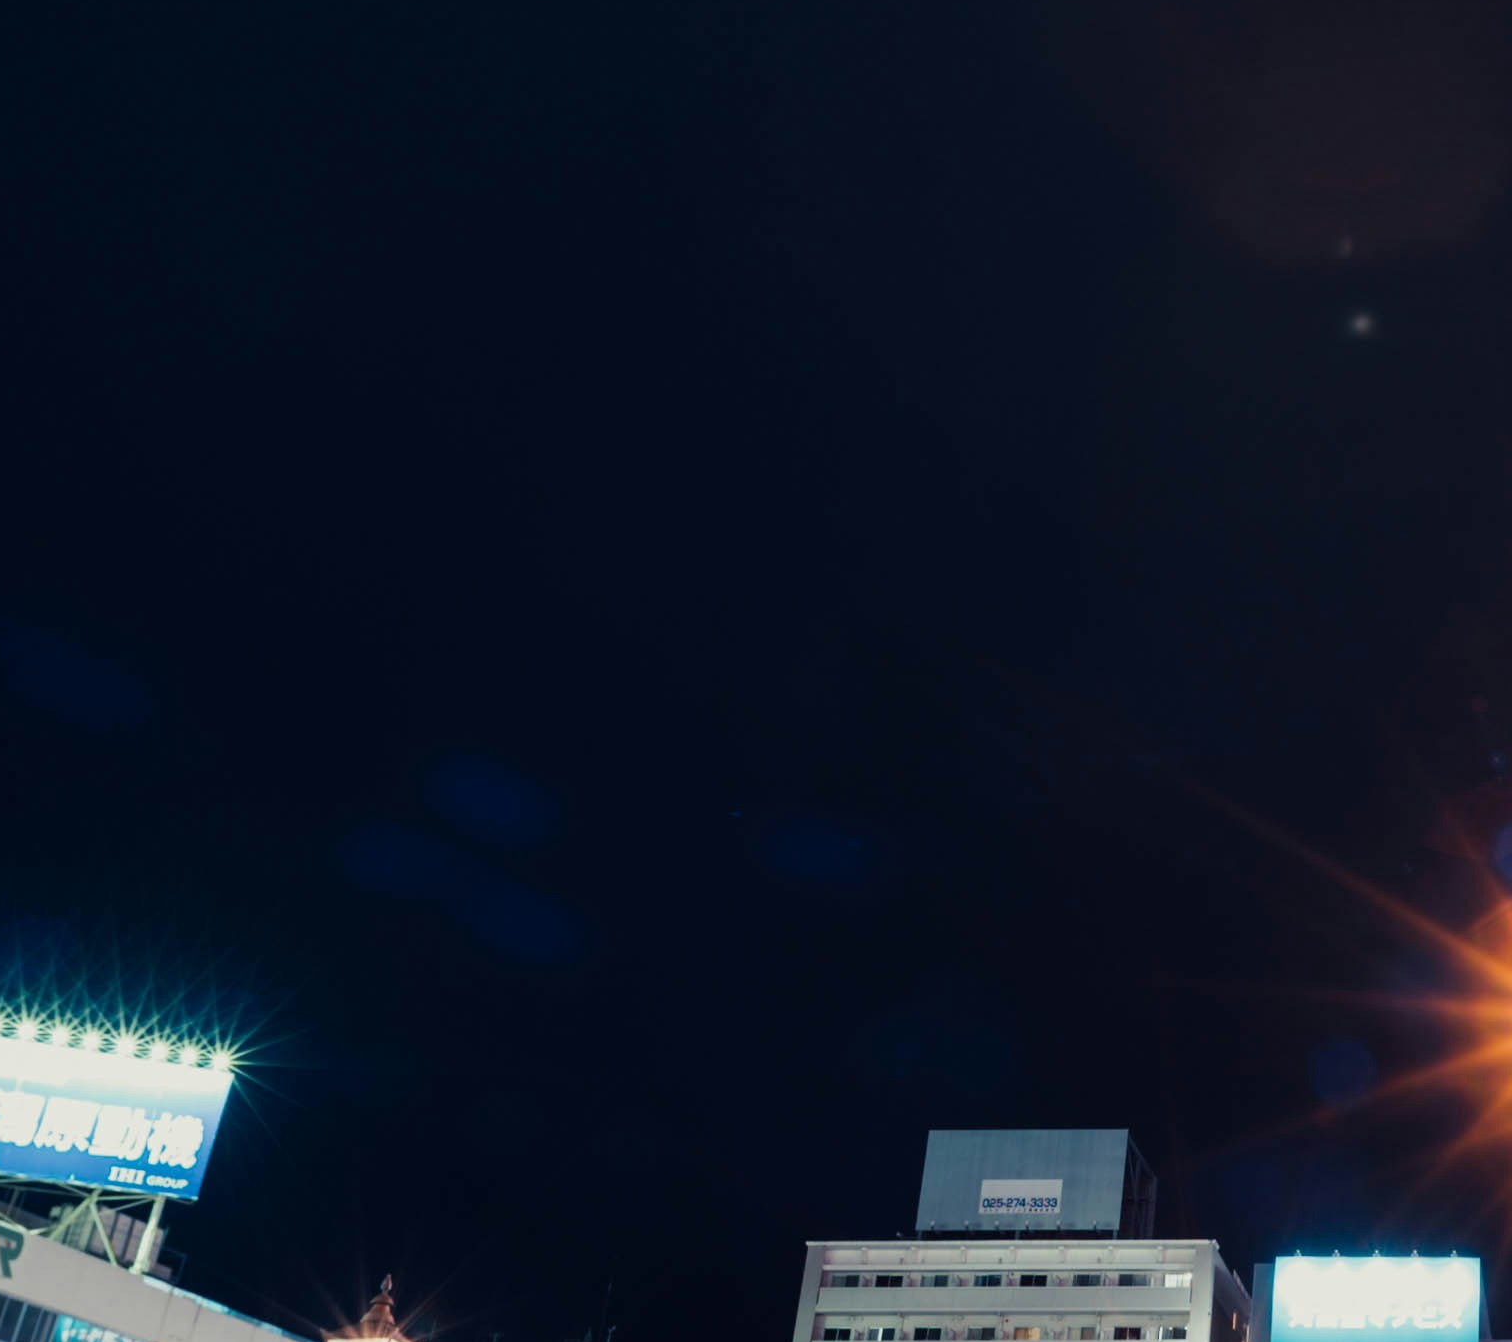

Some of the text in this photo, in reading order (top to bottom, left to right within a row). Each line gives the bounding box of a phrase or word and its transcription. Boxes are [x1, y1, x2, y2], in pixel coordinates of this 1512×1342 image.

[108, 1165, 189, 1190] IHI GROUP
[982, 1196, 1058, 1209] 025-274-3333
